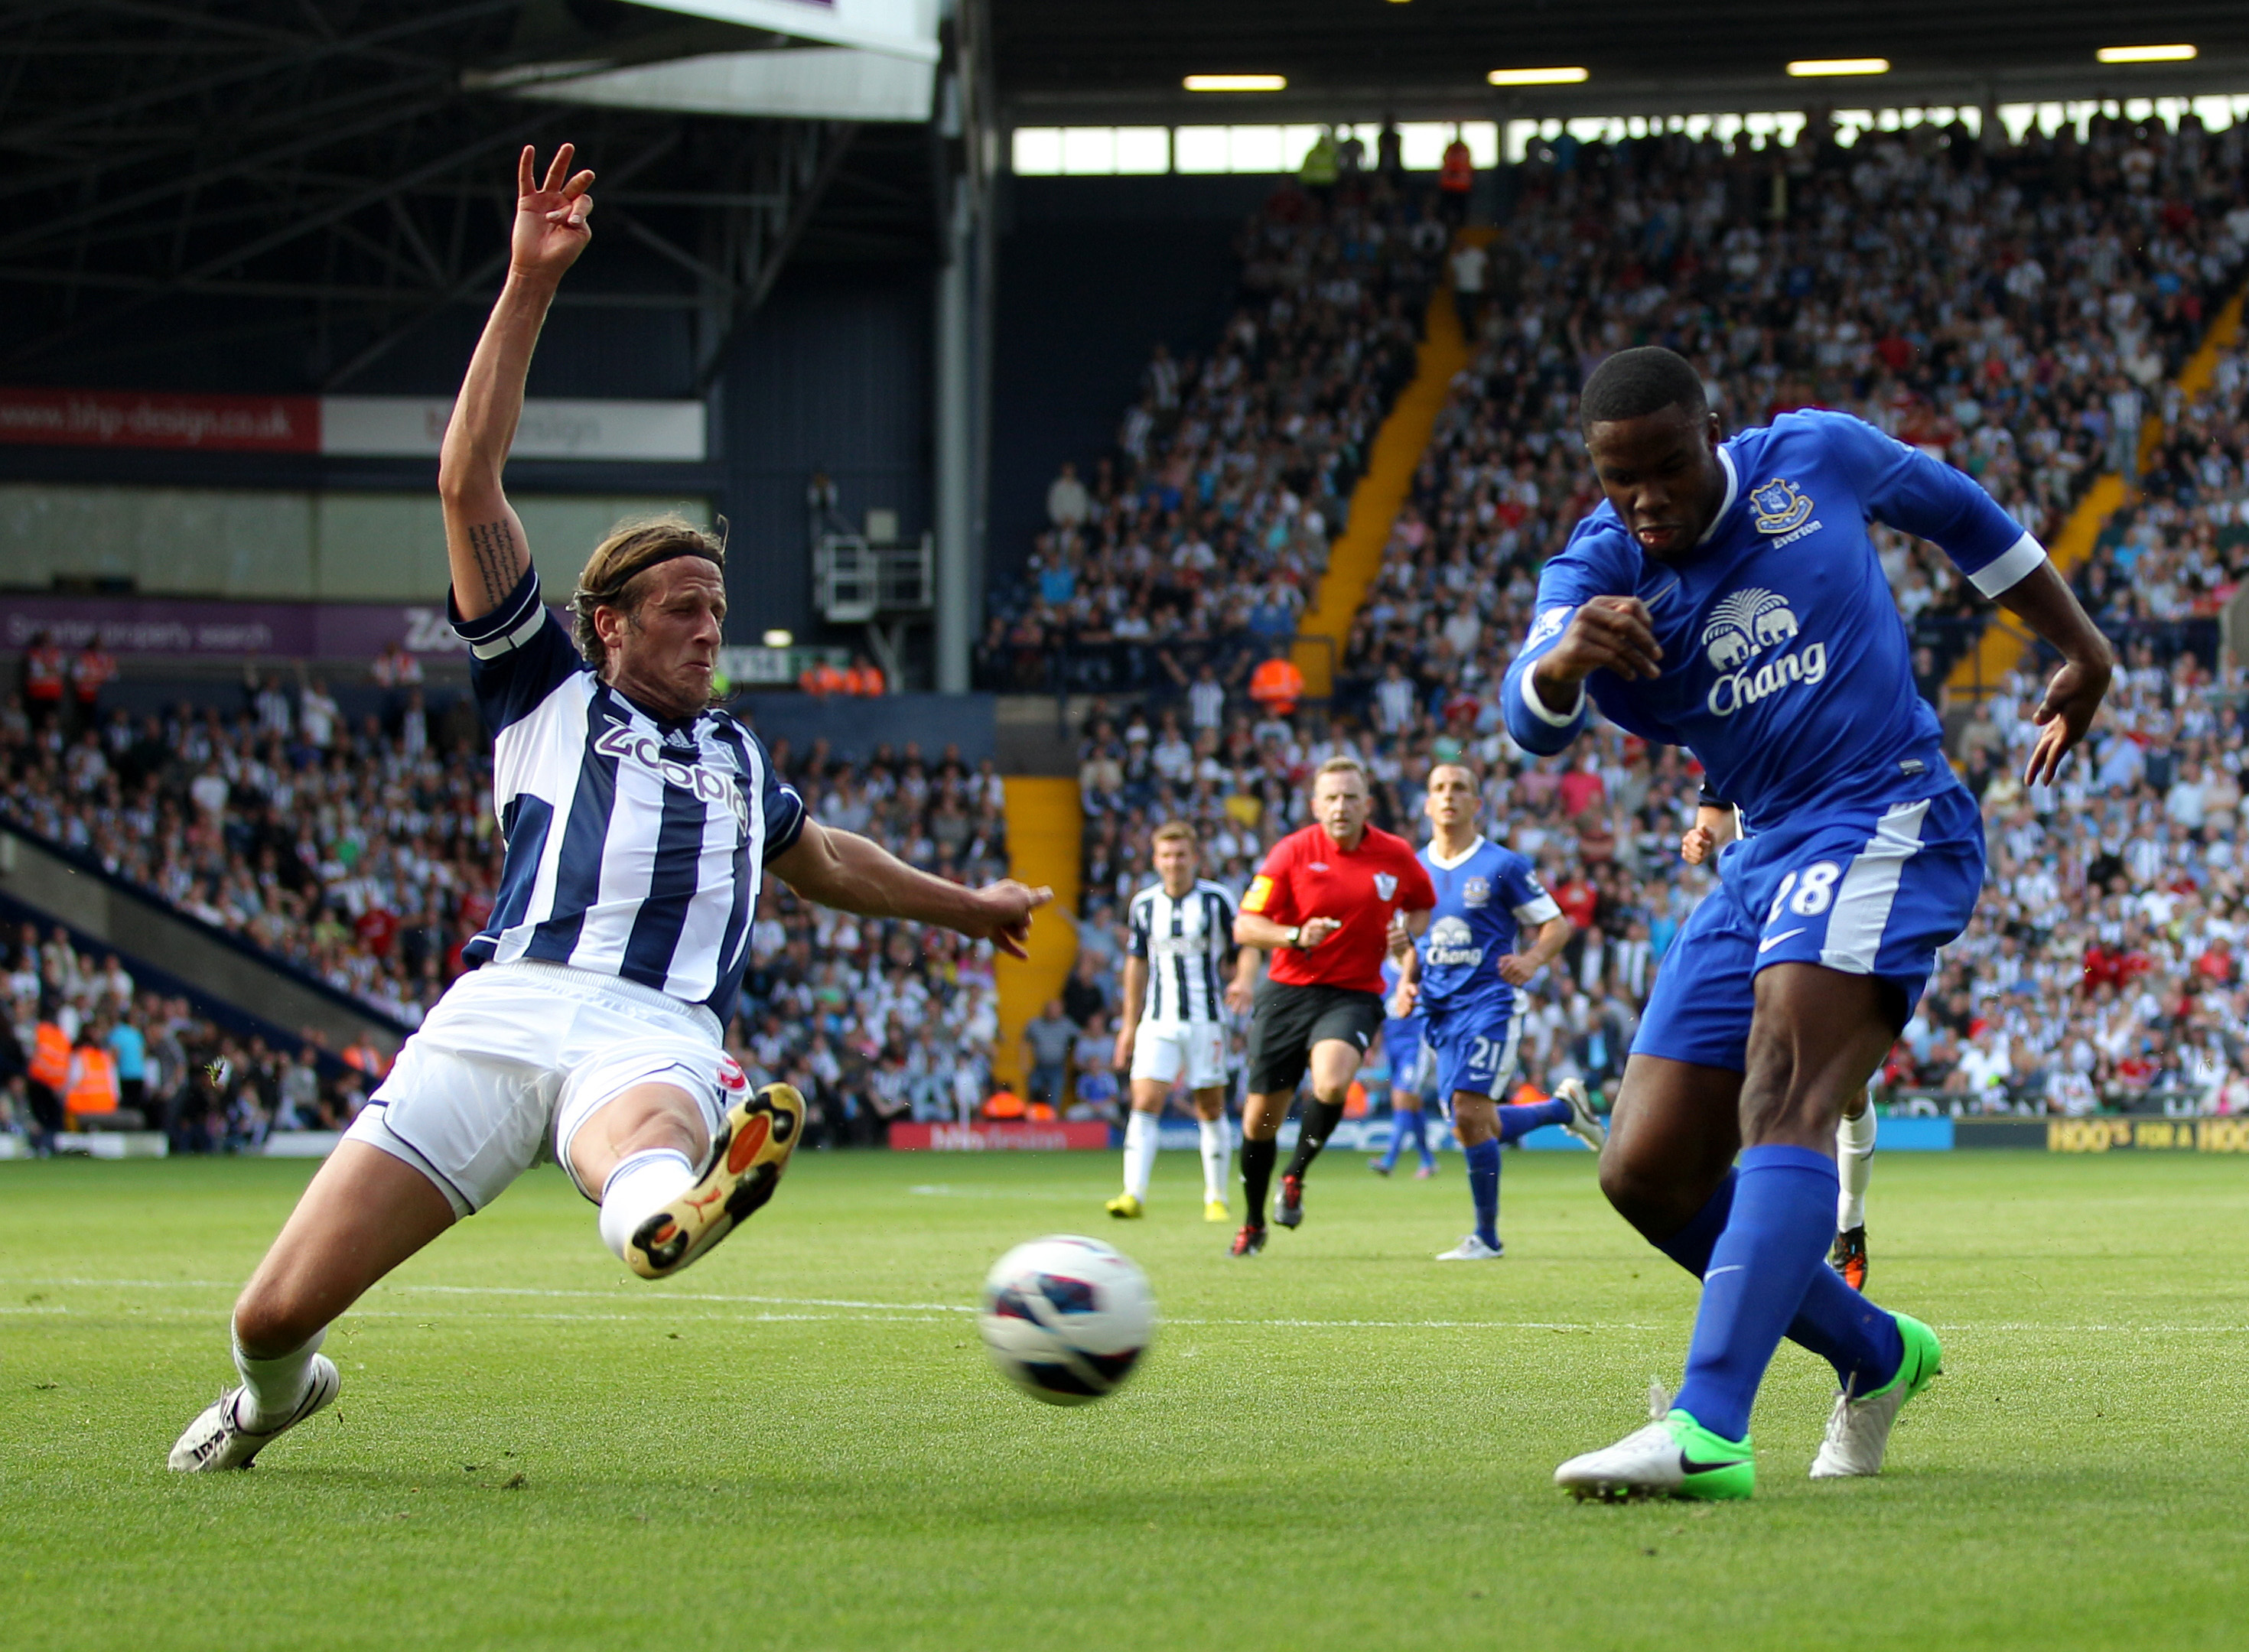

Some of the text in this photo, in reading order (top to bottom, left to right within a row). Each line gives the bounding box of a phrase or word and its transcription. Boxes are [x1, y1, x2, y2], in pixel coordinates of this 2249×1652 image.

[1772, 520, 1822, 549] Everton
[1707, 642, 1827, 716] Chang
[1468, 1035, 1502, 1072] 21
